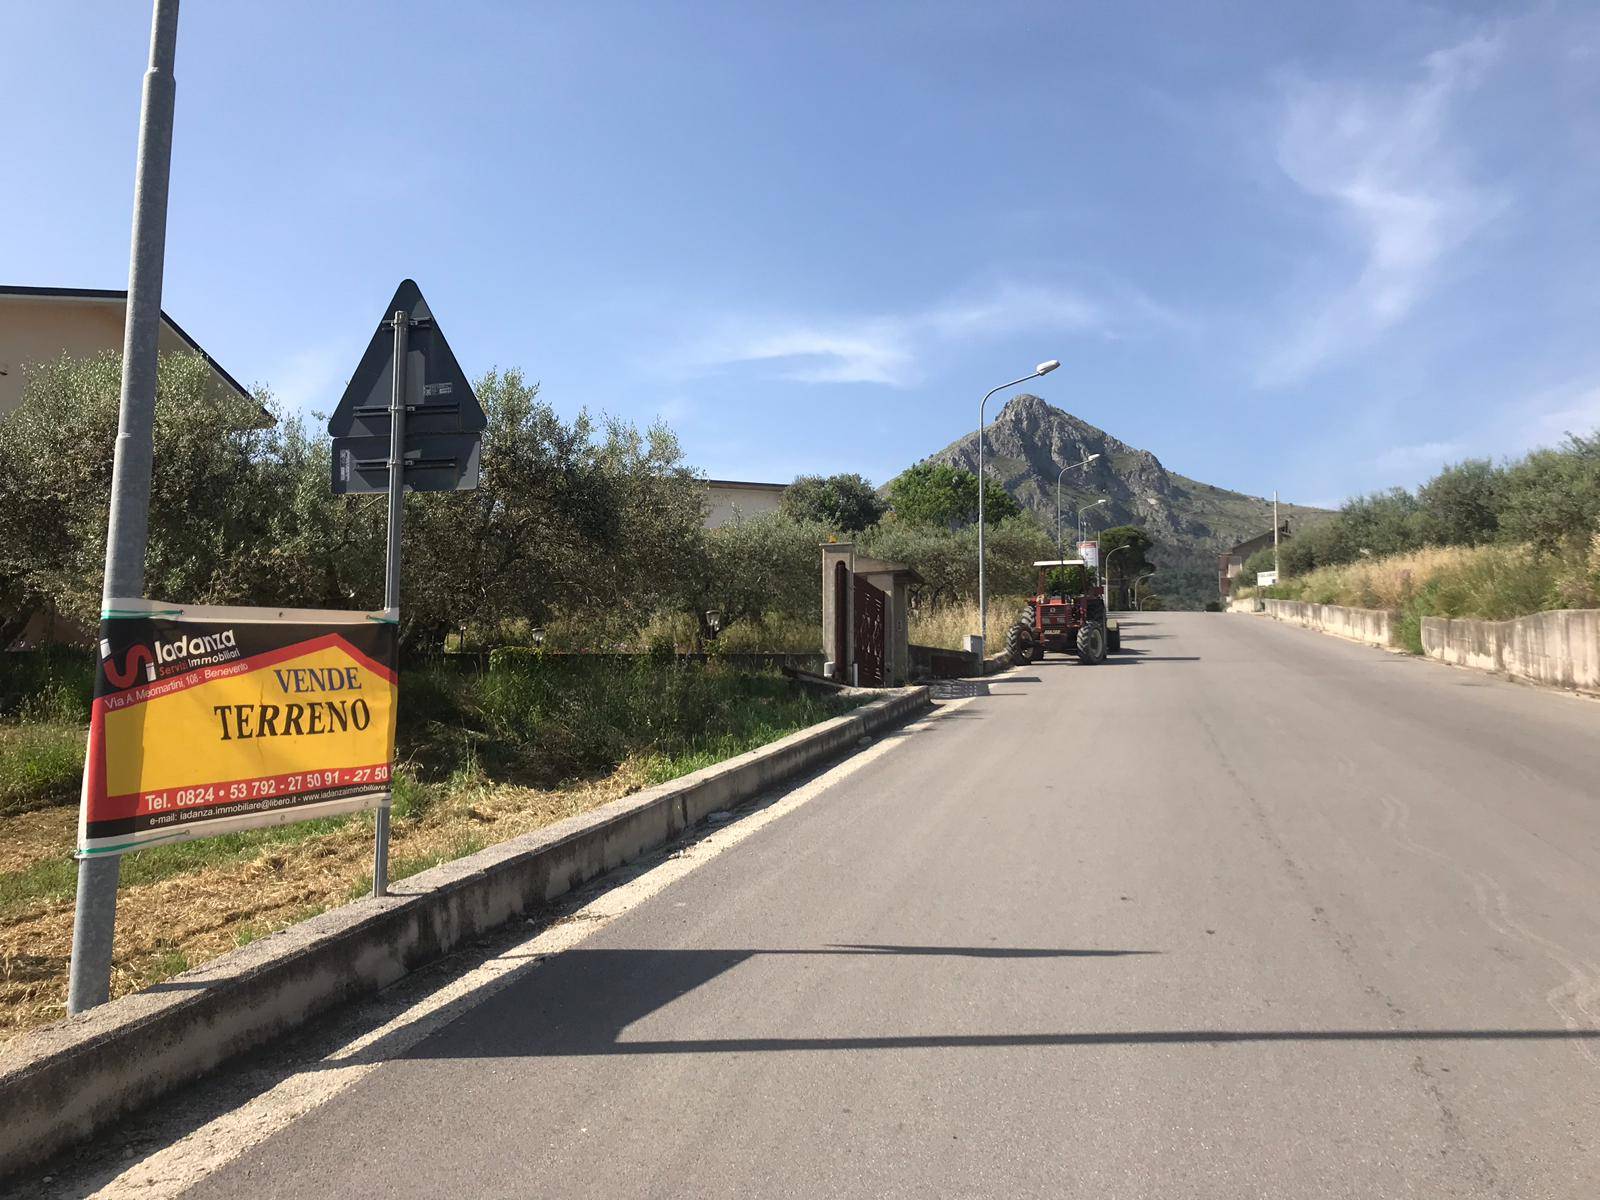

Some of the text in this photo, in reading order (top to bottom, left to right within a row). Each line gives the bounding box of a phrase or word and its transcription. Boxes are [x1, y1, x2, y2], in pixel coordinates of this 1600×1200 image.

[104, 697, 124, 709] Via
[204, 663, 249, 679] Benevento
[274, 667, 362, 693] VENDE
[214, 698, 370, 740] TERRENO
[145, 793, 171, 811] Tel.
[177, 787, 214, 806] 0824
[230, 783, 247, 799] 53
[252, 780, 276, 796] 792
[288, 776, 302, 791] 27
[306, 773, 321, 788] 50
[324, 770, 340, 785] 91
[353, 769, 371, 782] 27
[374, 766, 388, 780] 50
[149, 813, 178, 825] e-mail:
[180, 796, 297, 820] iadanza.immobiliare@libero.it
